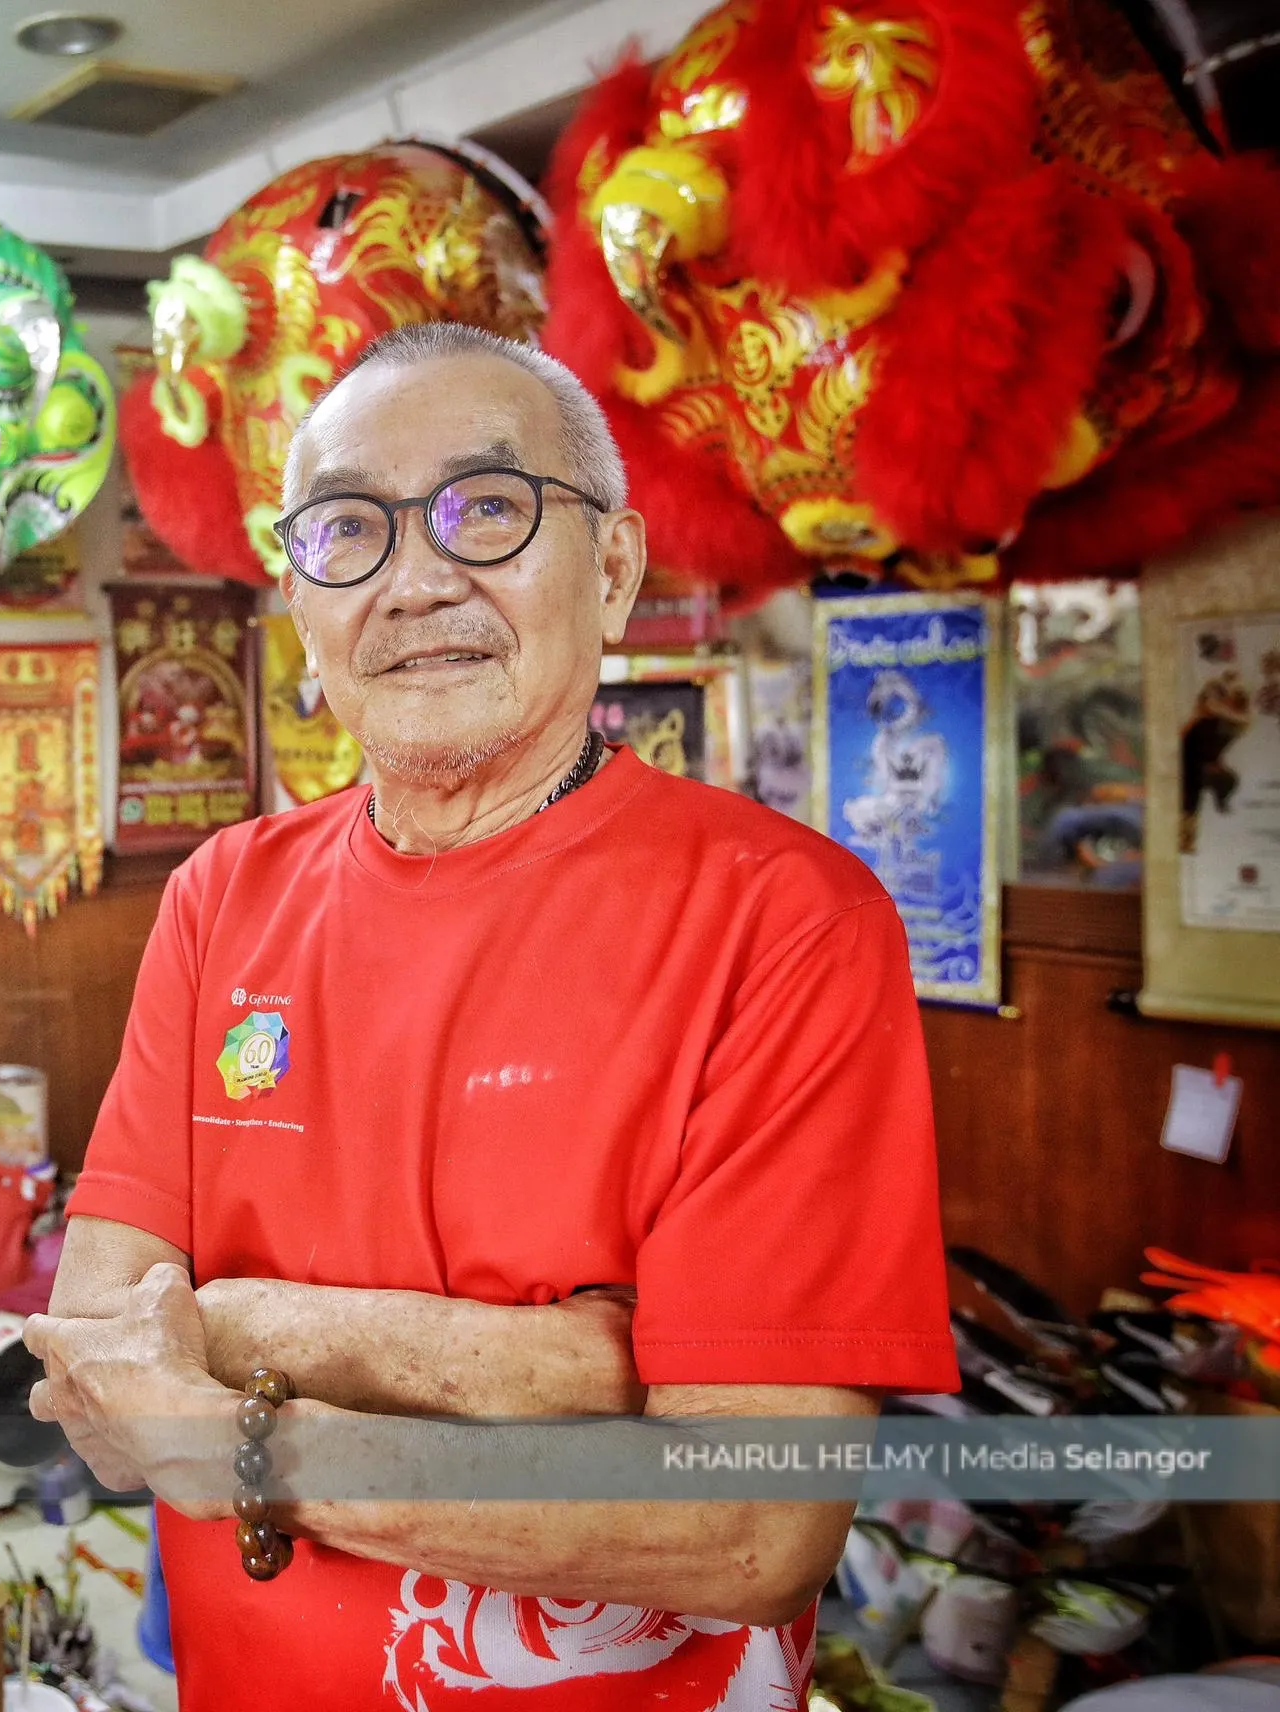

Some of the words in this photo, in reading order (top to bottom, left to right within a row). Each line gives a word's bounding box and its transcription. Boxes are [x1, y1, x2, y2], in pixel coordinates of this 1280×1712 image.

[244, 1040, 271, 1064] 60
[192, 1114, 231, 1126] onsolidate
[268, 1119, 304, 1132] Enduring
